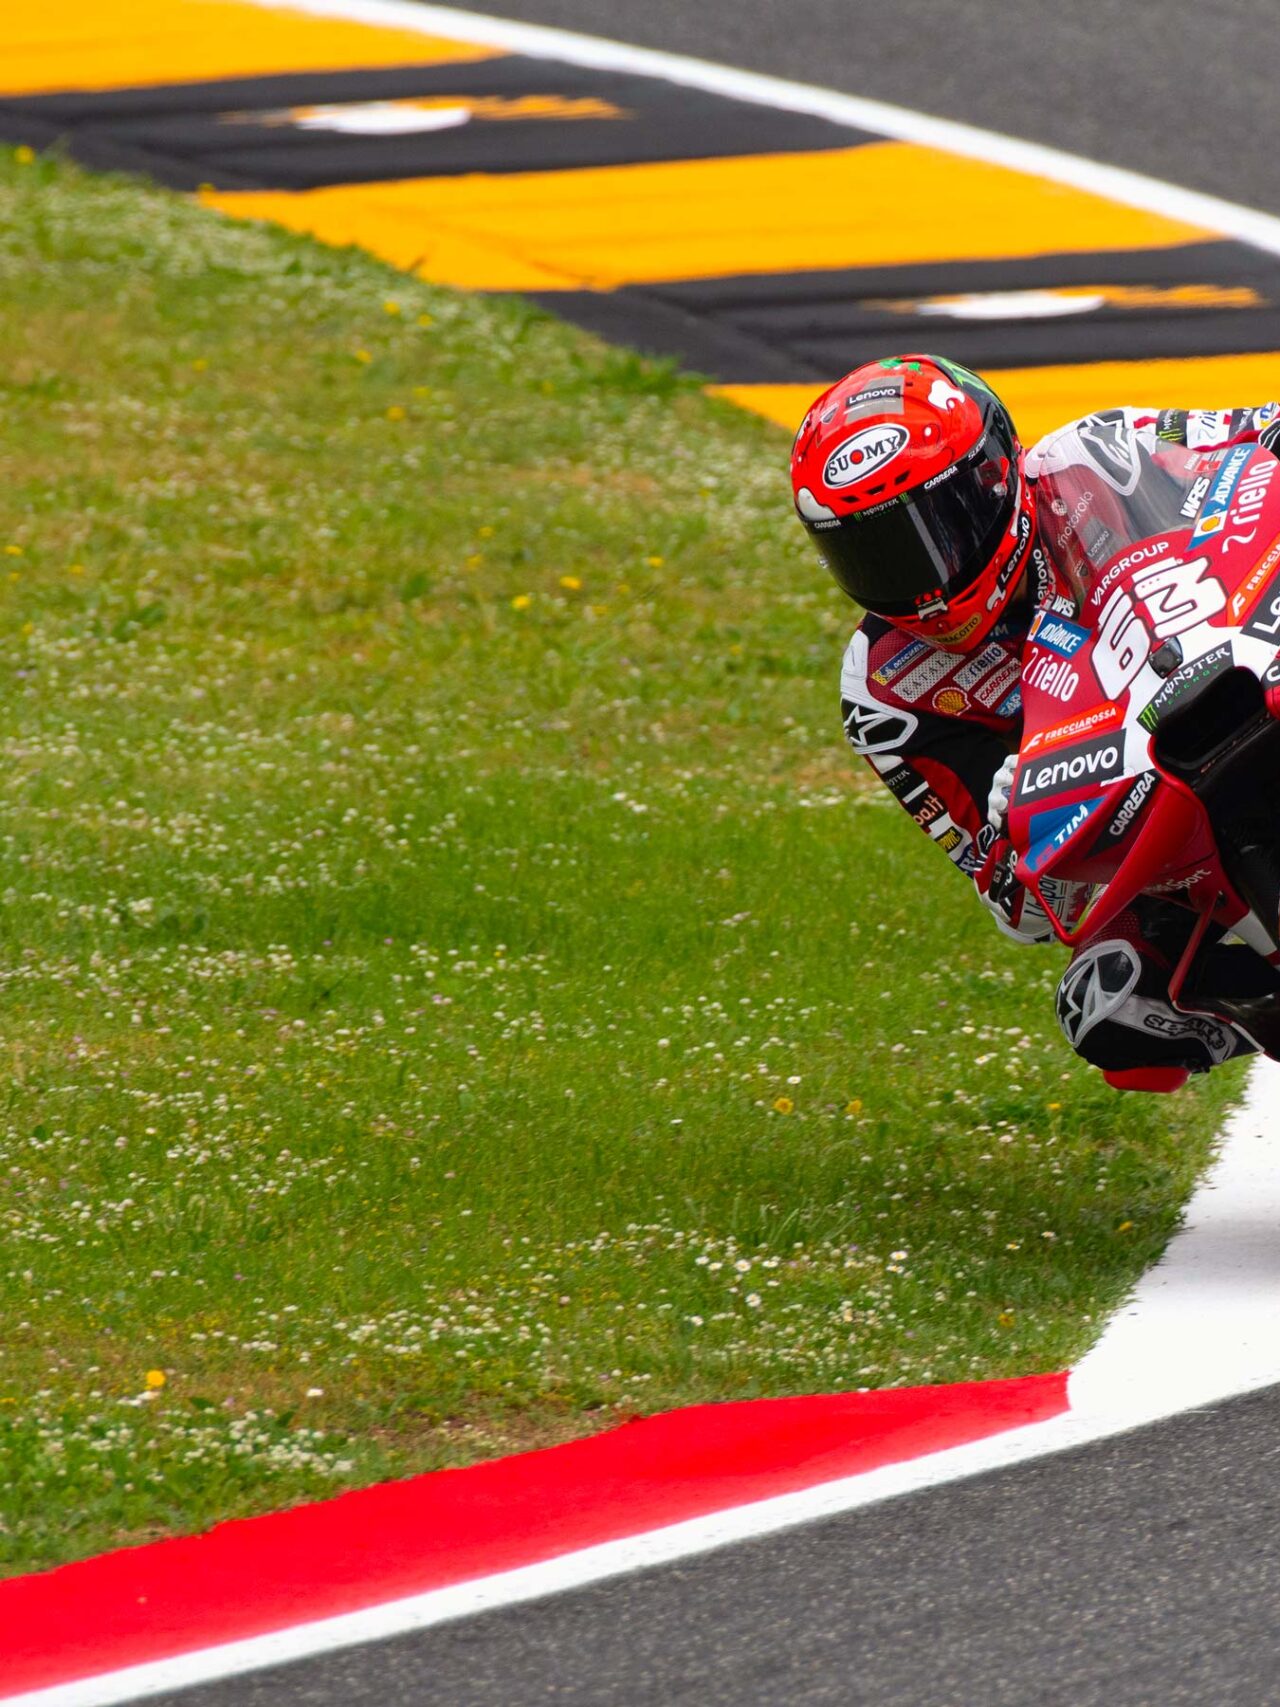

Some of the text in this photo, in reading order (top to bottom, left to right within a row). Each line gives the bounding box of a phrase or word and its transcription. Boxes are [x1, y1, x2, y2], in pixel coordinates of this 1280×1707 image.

[848, 388, 896, 404] Lenovo
[828, 435, 899, 477] SUOMY
[923, 465, 958, 490] CARRERA
[1210, 447, 1251, 506] ADVANCE
[1180, 476, 1211, 519] WRS
[1229, 459, 1279, 526] riello
[1058, 491, 1094, 550] motorola
[1001, 515, 1031, 583] Lenovo
[1091, 541, 1170, 607] VARGROUP
[1051, 594, 1076, 618] WRS
[1037, 622, 1083, 658] ADVANCE
[902, 653, 953, 696] EATALY
[1028, 653, 1080, 702] riello
[1154, 645, 1231, 709] MONSTER
[1044, 707, 1117, 745] FRECCIAROSSA
[1021, 746, 1119, 795] Lenovo
[1054, 803, 1090, 845] TIM
[1109, 772, 1156, 837] CARRERA
